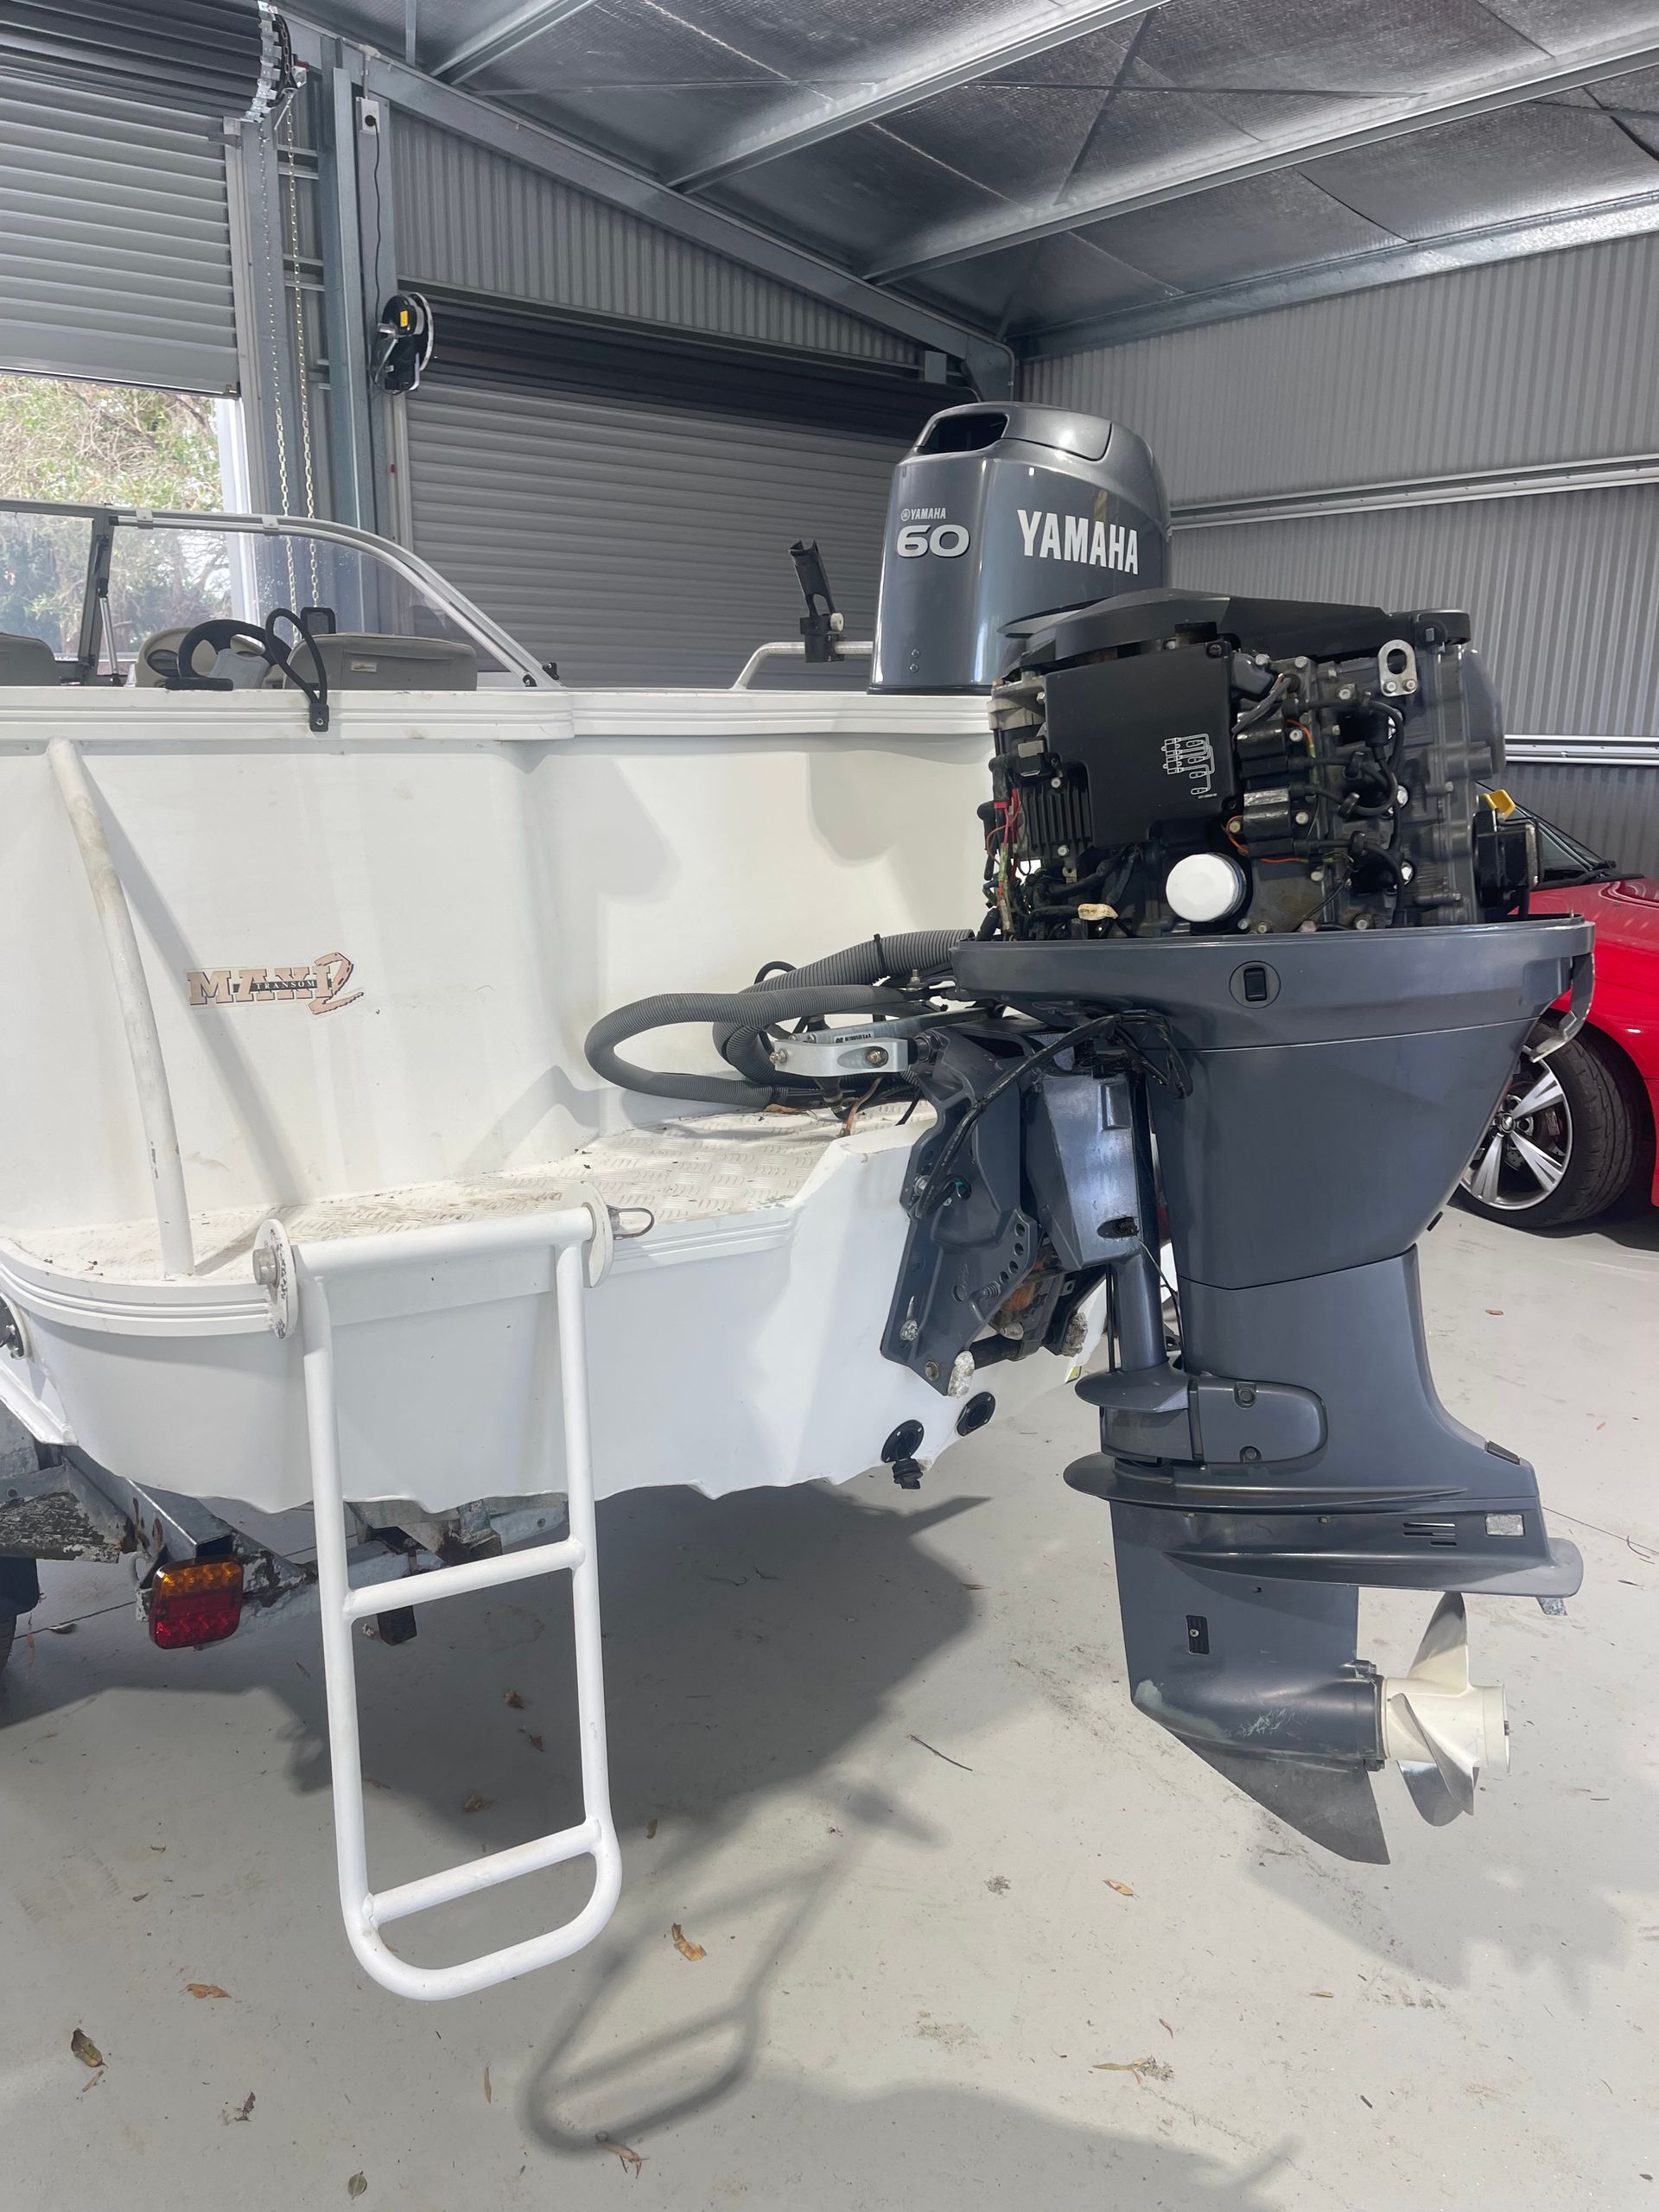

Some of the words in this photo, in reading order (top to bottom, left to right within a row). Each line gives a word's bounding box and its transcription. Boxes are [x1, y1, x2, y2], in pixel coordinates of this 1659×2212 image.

[910, 507, 946, 520] YAMAHA
[896, 524, 969, 558] 60
[1017, 509, 1139, 575] YAMAHA
[255, 979, 316, 991] TRANSOM
